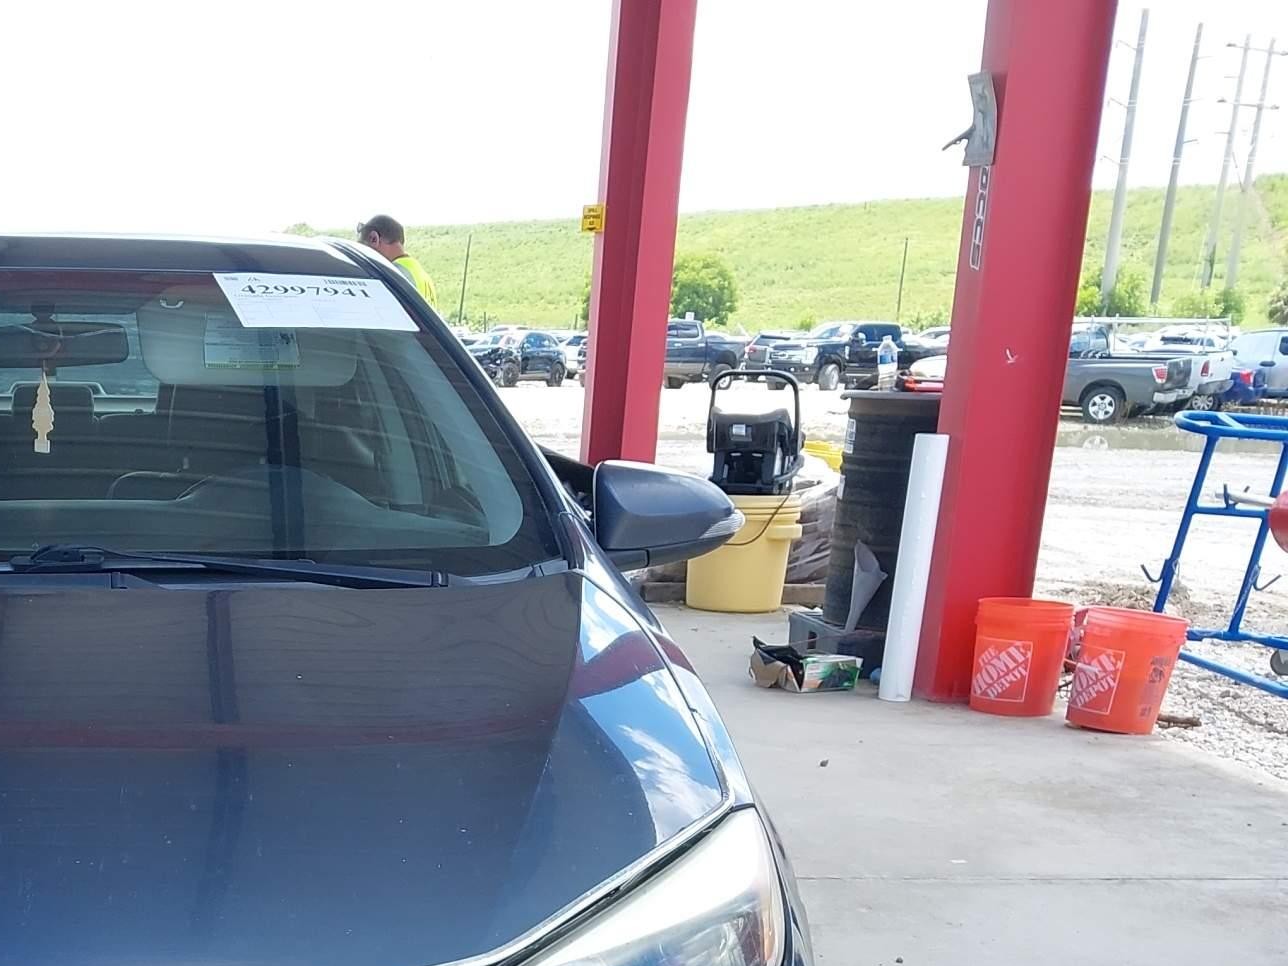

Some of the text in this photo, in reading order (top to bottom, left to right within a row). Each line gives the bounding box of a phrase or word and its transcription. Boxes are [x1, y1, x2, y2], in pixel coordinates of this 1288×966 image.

[240, 283, 372, 299] 42997941
[973, 641, 1031, 695] HOME
[986, 664, 1028, 699] DEPOT
